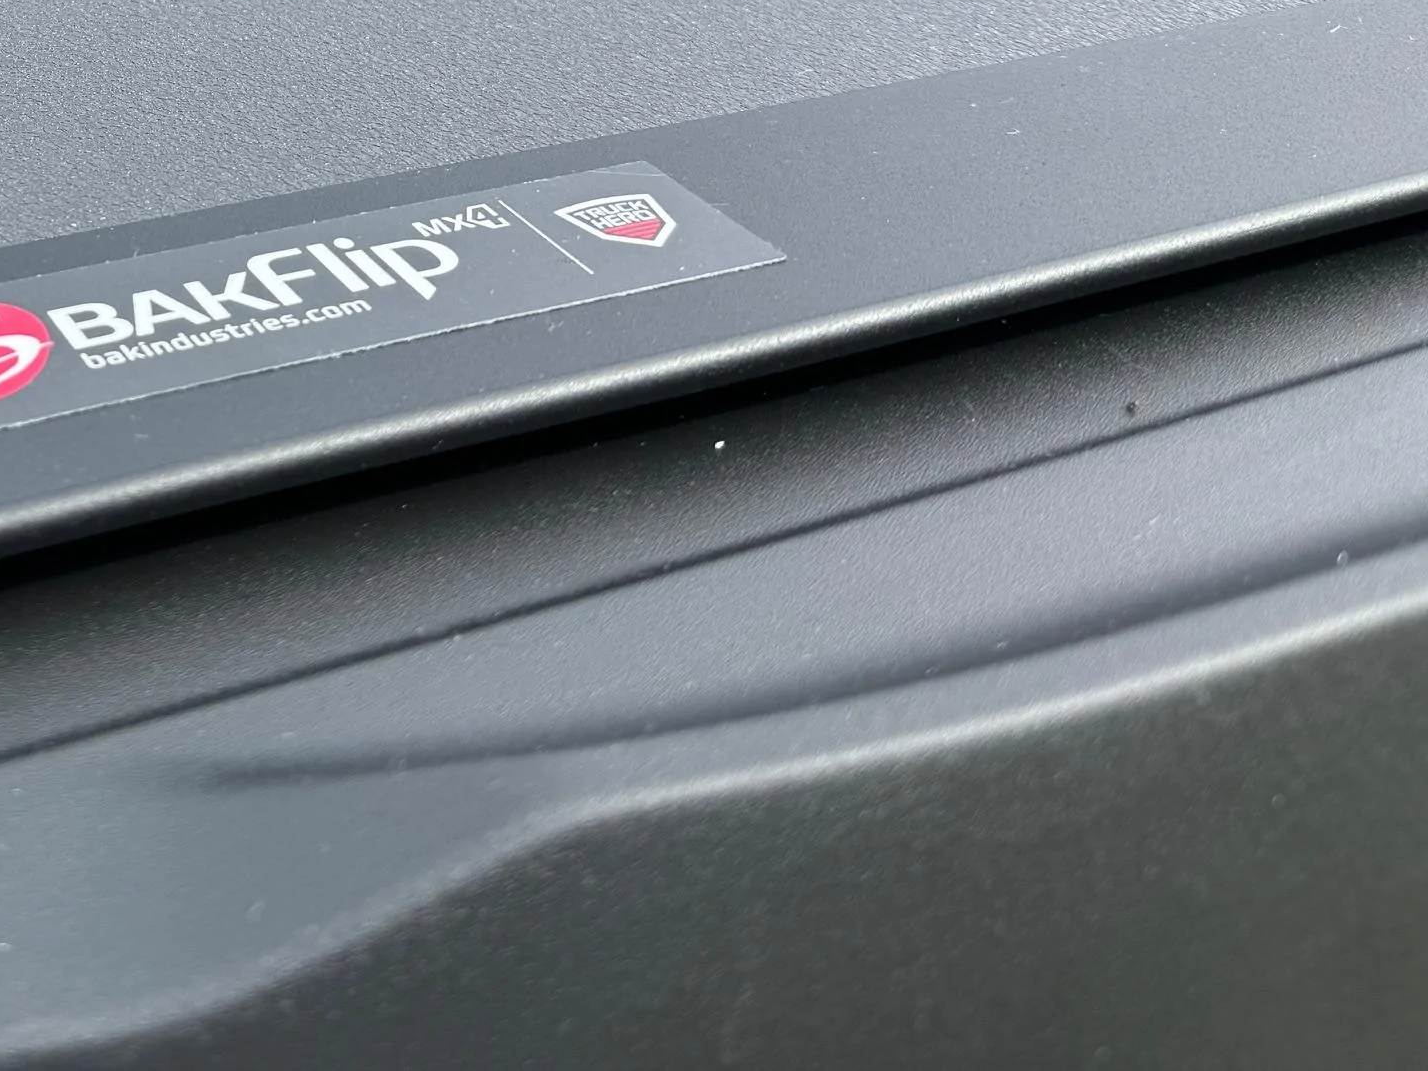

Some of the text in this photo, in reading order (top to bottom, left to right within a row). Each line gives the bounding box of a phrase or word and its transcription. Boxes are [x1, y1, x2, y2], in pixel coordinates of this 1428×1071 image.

[412, 203, 511, 237] MX4
[573, 200, 650, 220] TRUCK
[590, 210, 657, 229] HERO
[80, 297, 372, 370] bakindustries.com
